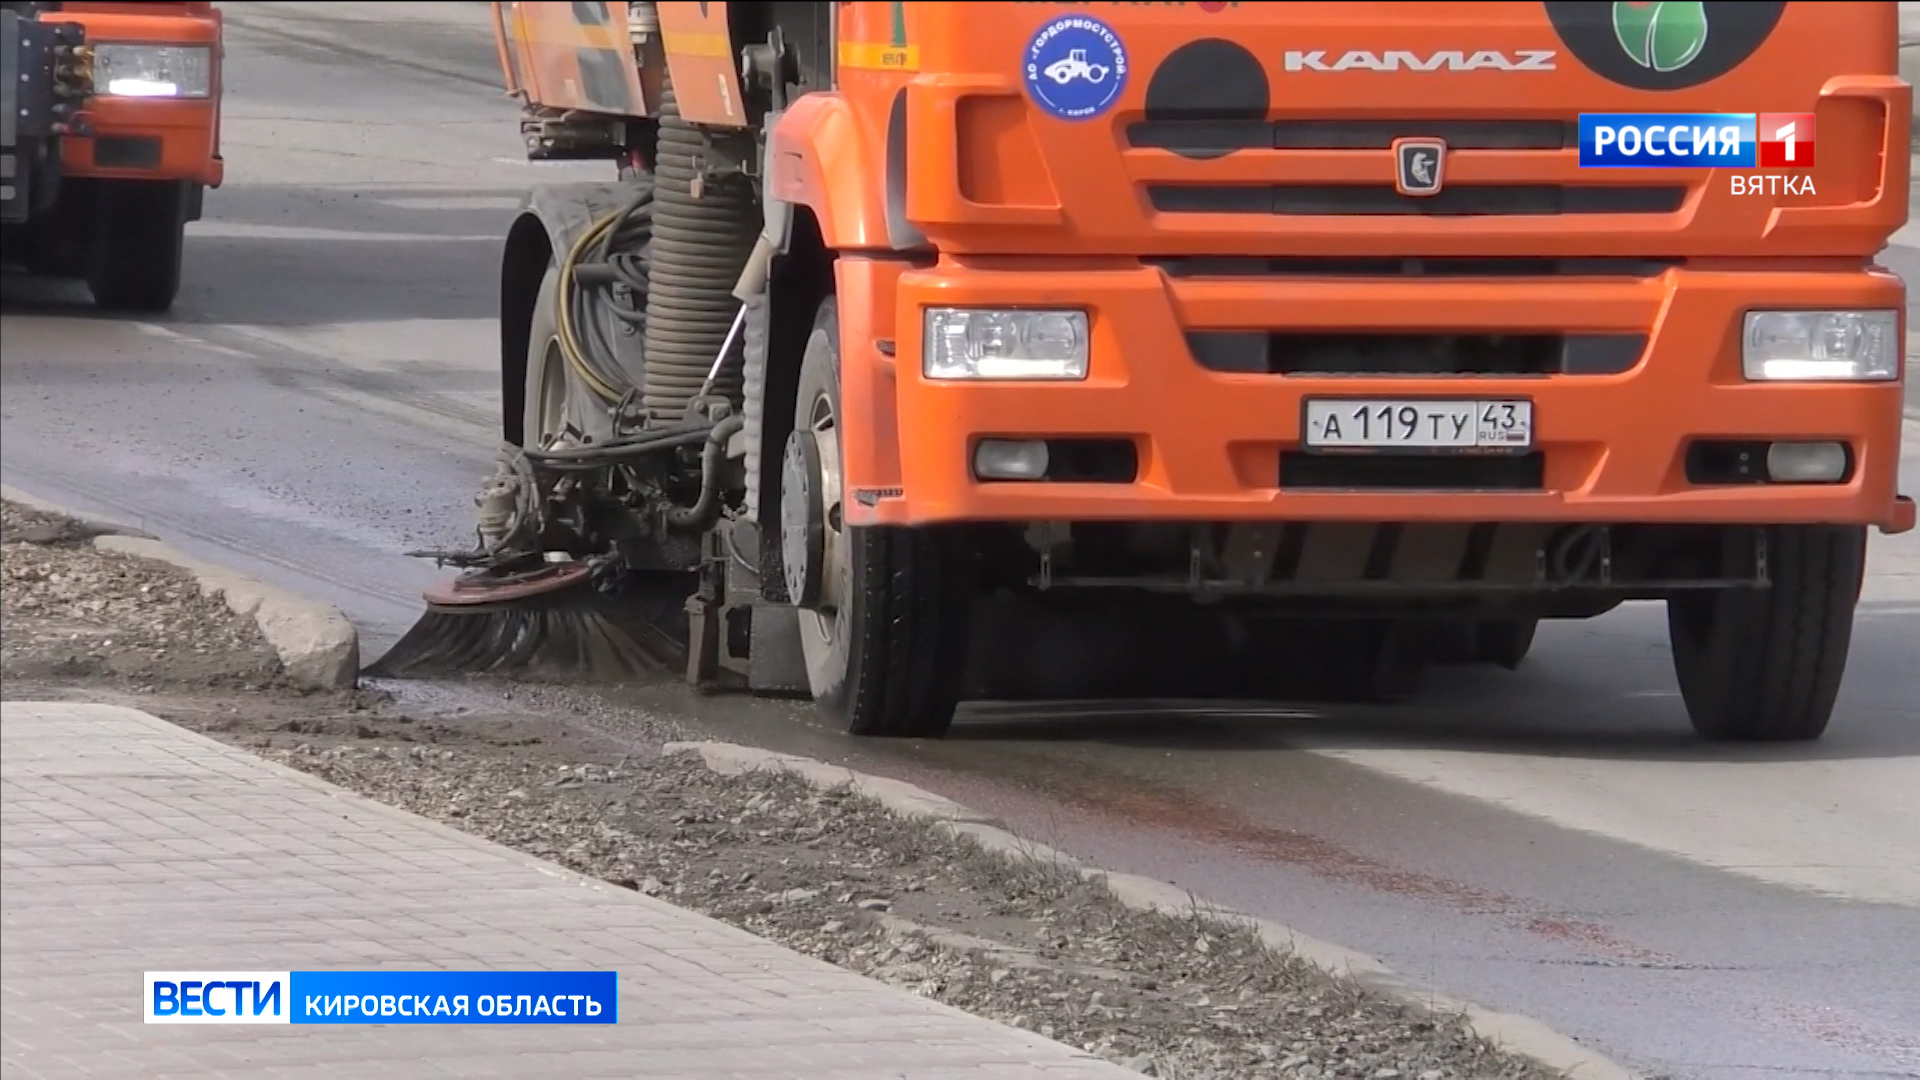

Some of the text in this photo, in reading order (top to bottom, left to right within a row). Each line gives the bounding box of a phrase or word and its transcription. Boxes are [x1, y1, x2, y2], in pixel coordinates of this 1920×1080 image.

[1284, 50, 1556, 71] KAMAZ
[1027, 63, 1038, 80] АО
[1482, 404, 1516, 430] 43
[1479, 431, 1504, 441] RUS
